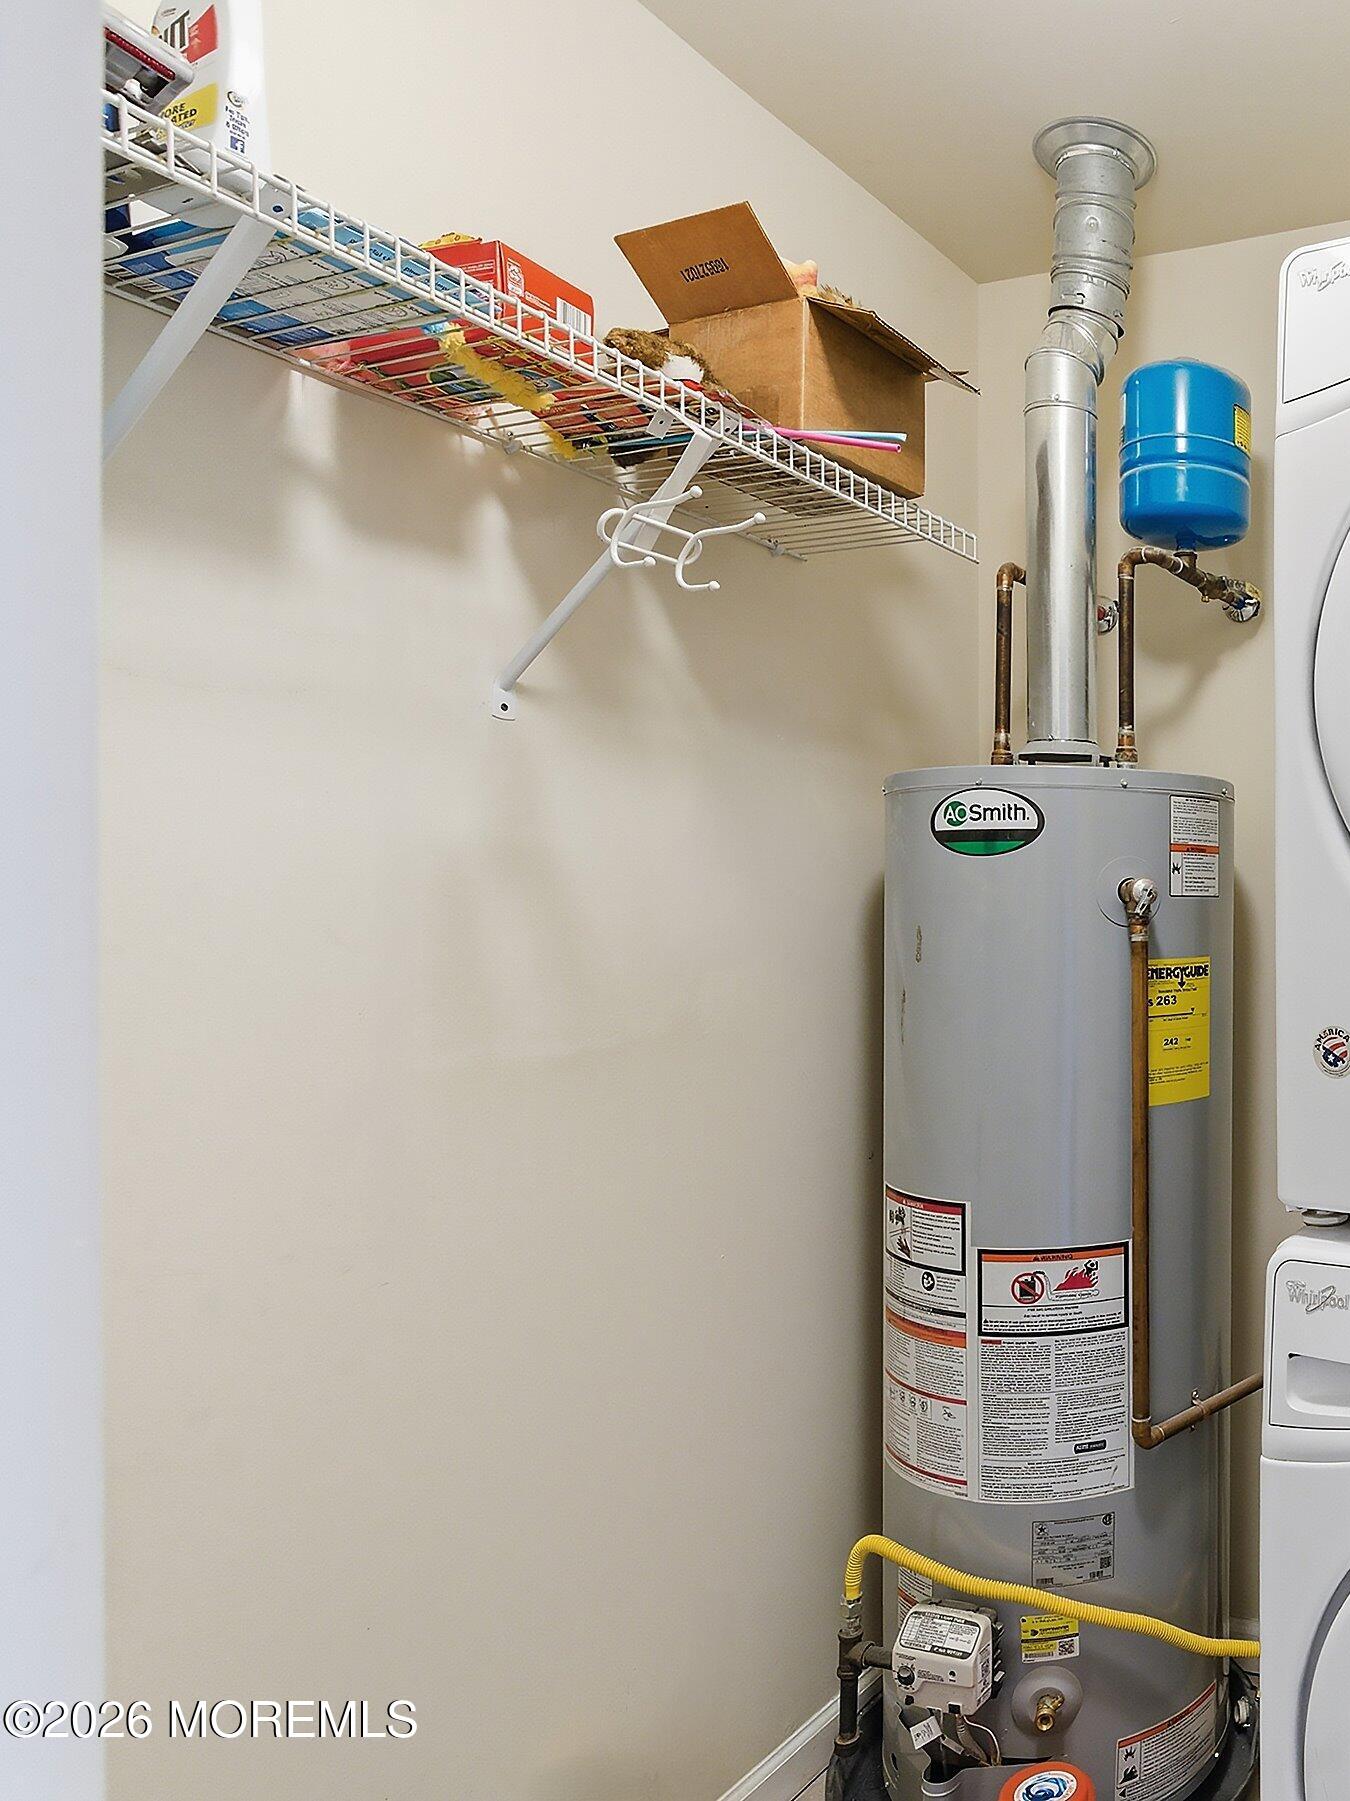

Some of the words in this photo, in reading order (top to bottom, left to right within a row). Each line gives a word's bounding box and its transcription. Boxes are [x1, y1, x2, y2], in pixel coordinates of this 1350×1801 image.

[171, 109, 197, 123] ATED
[1156, 995, 1178, 1007] 263
[1163, 1037, 1179, 1047] 242
[1314, 1027, 1350, 1052] AMERICA
[1286, 1280, 1350, 1314] Whirlpool
